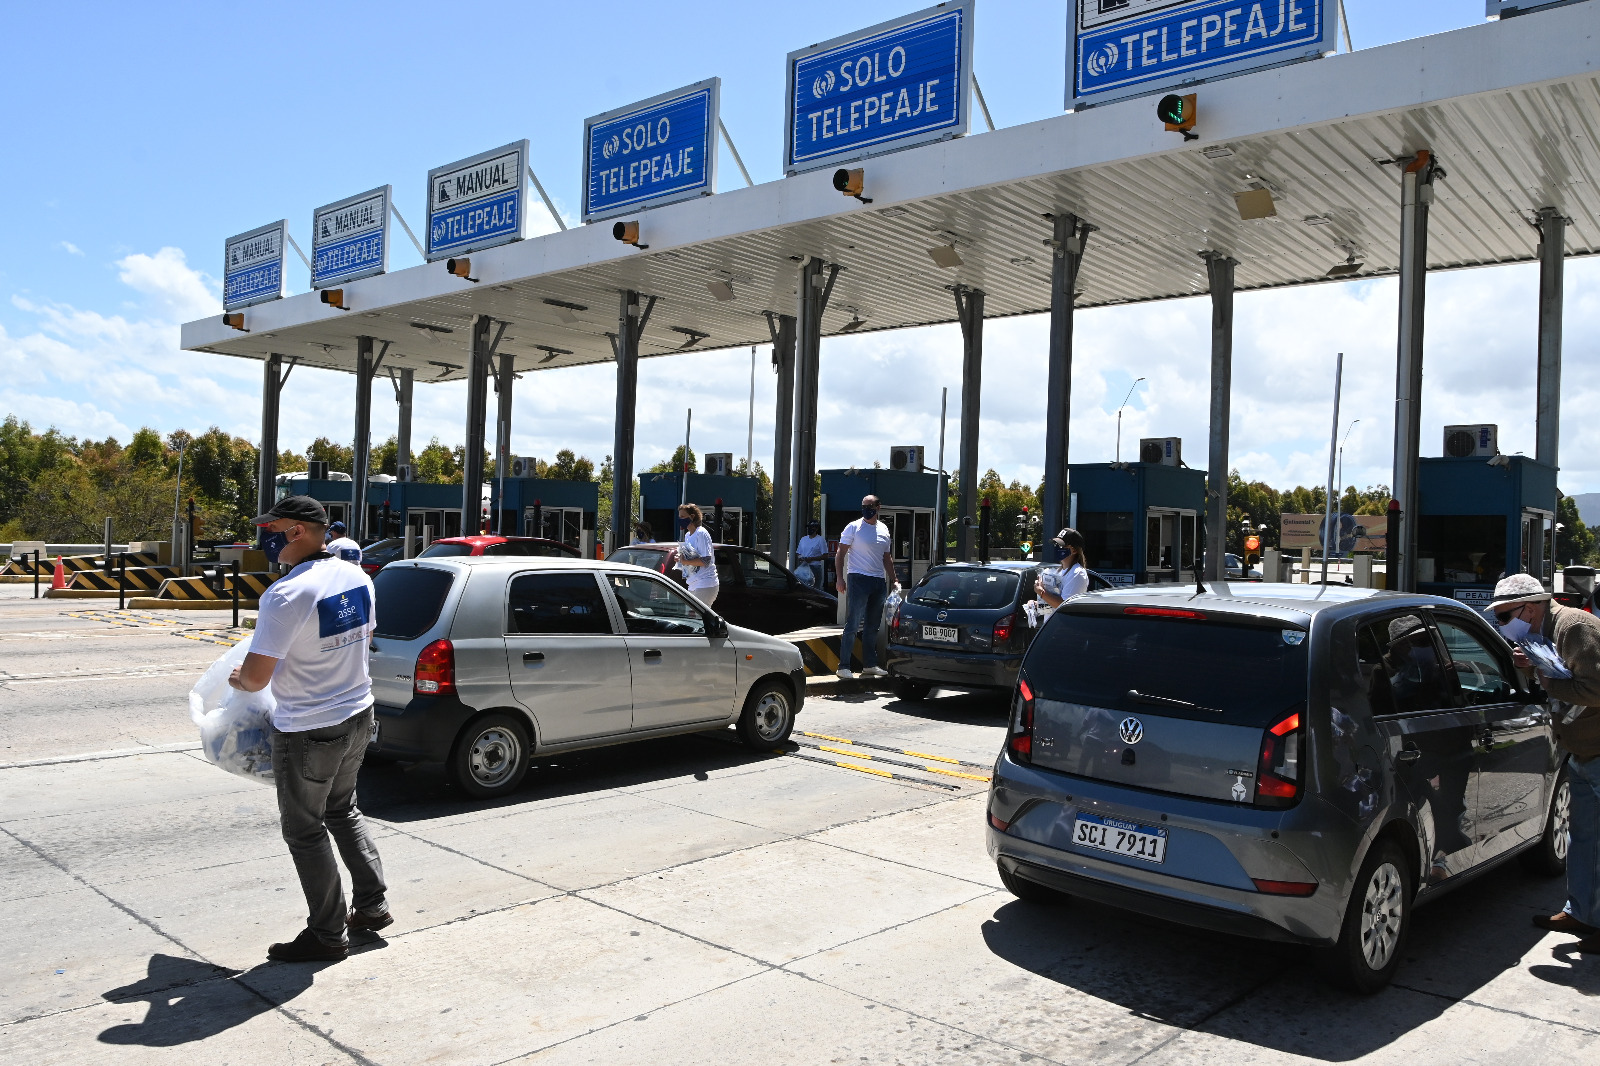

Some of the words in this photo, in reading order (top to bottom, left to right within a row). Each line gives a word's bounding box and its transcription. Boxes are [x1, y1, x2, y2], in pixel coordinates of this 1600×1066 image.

[1120, 0, 1307, 71] TELEPEAJE
[839, 45, 906, 92] SOLO
[808, 79, 940, 142] TELEPEAJE
[622, 116, 670, 155] SOLO
[456, 162, 509, 198] MANUAL
[600, 146, 694, 196] TELEPEAJE
[335, 204, 376, 234] MANUAL
[446, 200, 514, 240] TELEPEAJE
[242, 235, 275, 263] MANUAL
[328, 238, 380, 271] TELEPEAJE
[236, 266, 279, 294] TELEPEAJE
[337, 605, 356, 619] asse
[1465, 592, 1495, 600] PEAJE
[924, 626, 937, 636] SBG
[1077, 823, 1108, 847] SCI
[1115, 831, 1158, 858] 7911
[1103, 818, 1137, 831] URUGUAY
